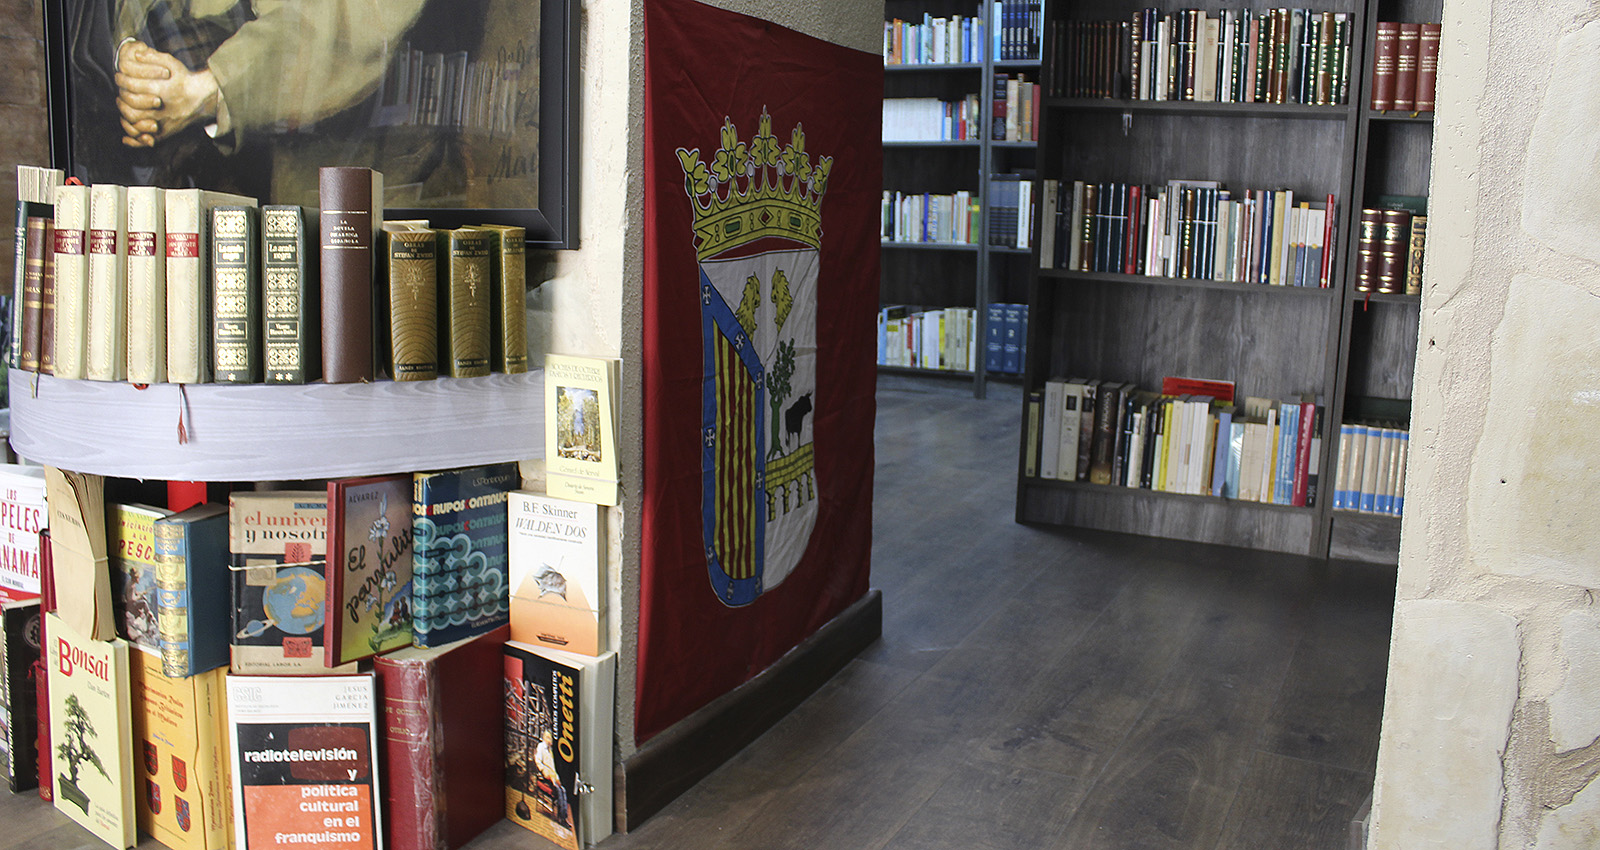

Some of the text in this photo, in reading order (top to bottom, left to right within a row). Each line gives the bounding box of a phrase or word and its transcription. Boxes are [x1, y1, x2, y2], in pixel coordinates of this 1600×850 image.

[7, 488, 17, 500] LOS
[349, 491, 379, 504] ALVAREZ
[1, 502, 39, 534] PELES
[244, 511, 262, 526] el
[266, 511, 326, 527] univer
[542, 504, 578, 520] Skinner
[246, 528, 326, 543] y nosotr
[516, 517, 562, 535] WALDEN
[564, 525, 588, 539] DOS
[119, 539, 155, 561] PESC
[348, 544, 367, 572] El
[0, 544, 39, 579] NAMÁ
[58, 636, 109, 683] Bonsai
[556, 671, 574, 762] Onetti
[244, 747, 358, 763] radiotelevisión
[347, 768, 357, 781] y
[299, 800, 359, 812] cultural
[323, 814, 360, 828] en el
[274, 831, 361, 845] franquismo
